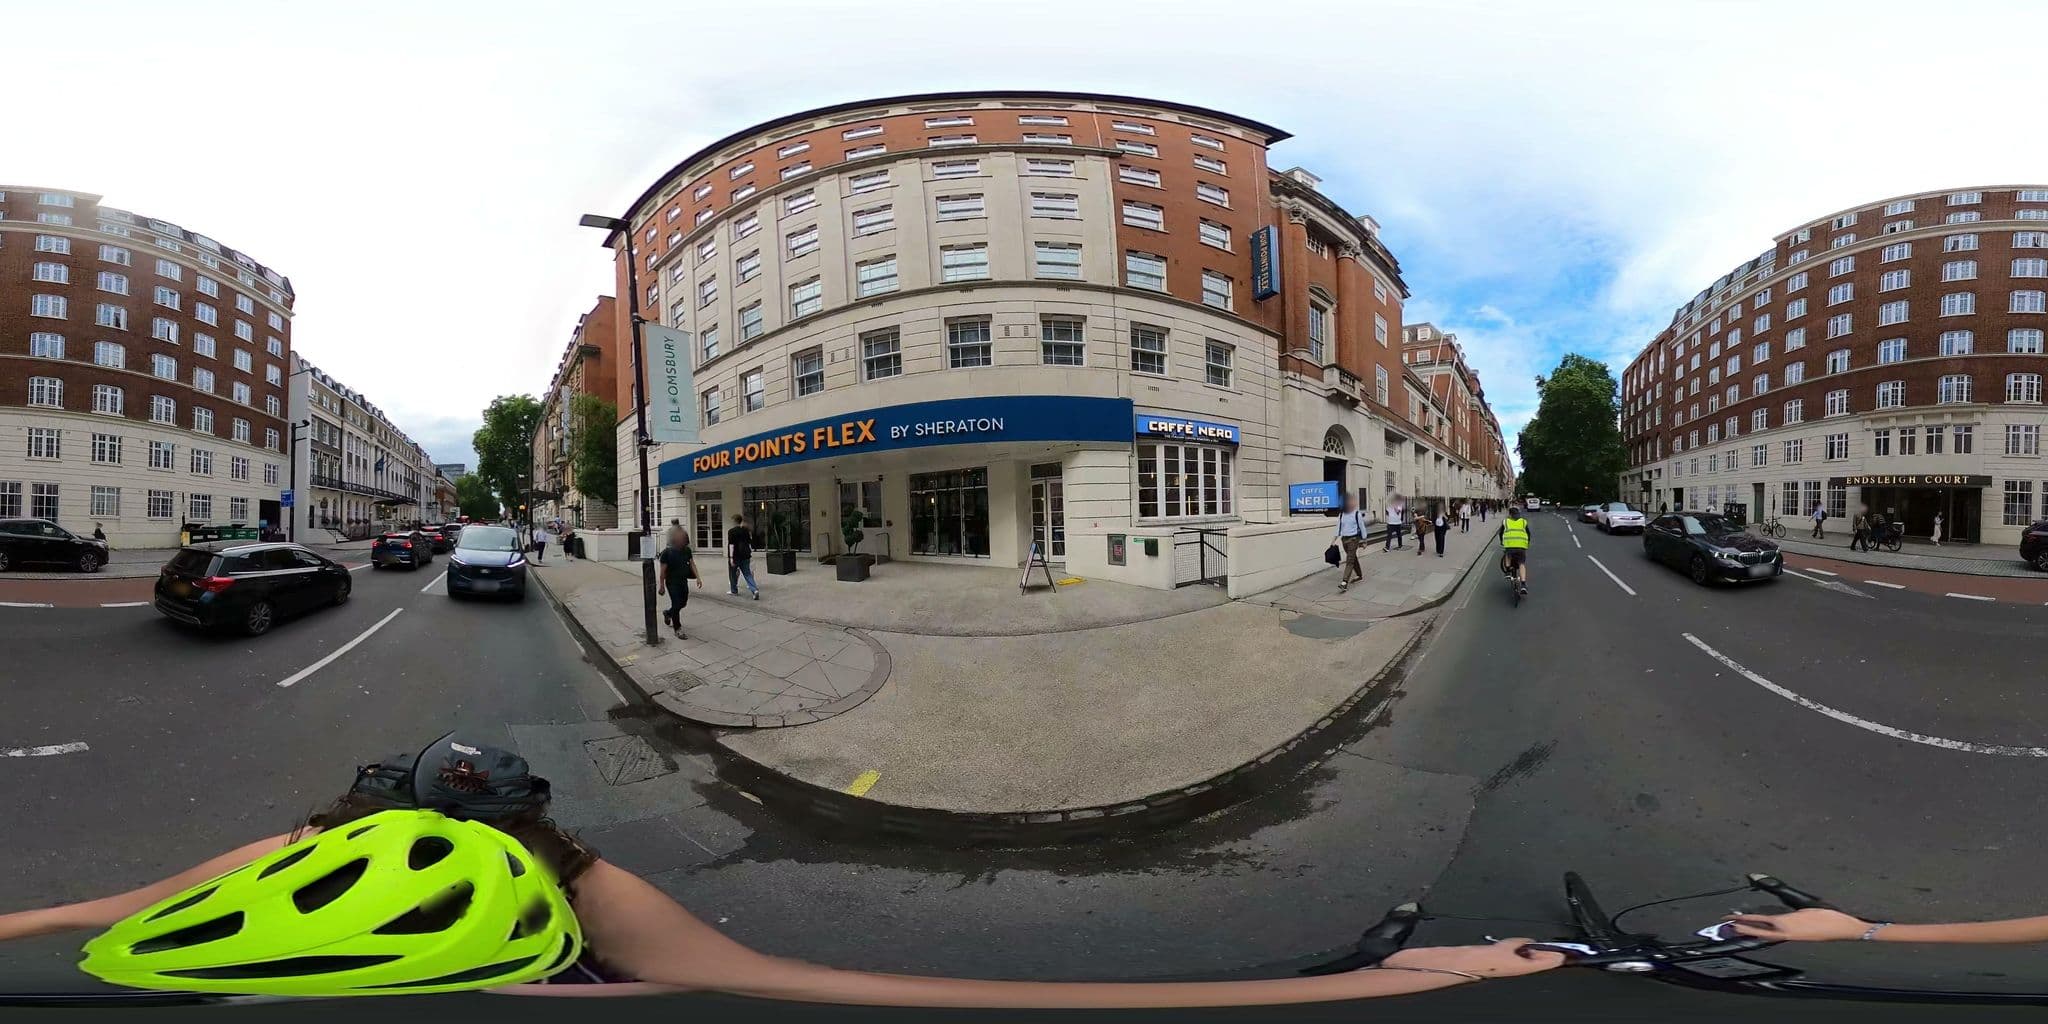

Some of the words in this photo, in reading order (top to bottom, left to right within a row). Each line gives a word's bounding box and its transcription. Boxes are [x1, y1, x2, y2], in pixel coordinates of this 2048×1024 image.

[1261, 272, 1269, 290] FLEX
[1148, 421, 1194, 434] CAFFÈ
[1198, 426, 1233, 439] NERO
[693, 450, 731, 473] FOUR
[734, 432, 807, 464] POINTS
[813, 418, 876, 450] FLEX
[890, 425, 909, 439] BY
[915, 418, 1004, 436] SHERATON
[1845, 475, 1917, 485] ENDSLEIGH
[1924, 475, 1970, 485] COURT
[1296, 495, 1330, 506] NERO
